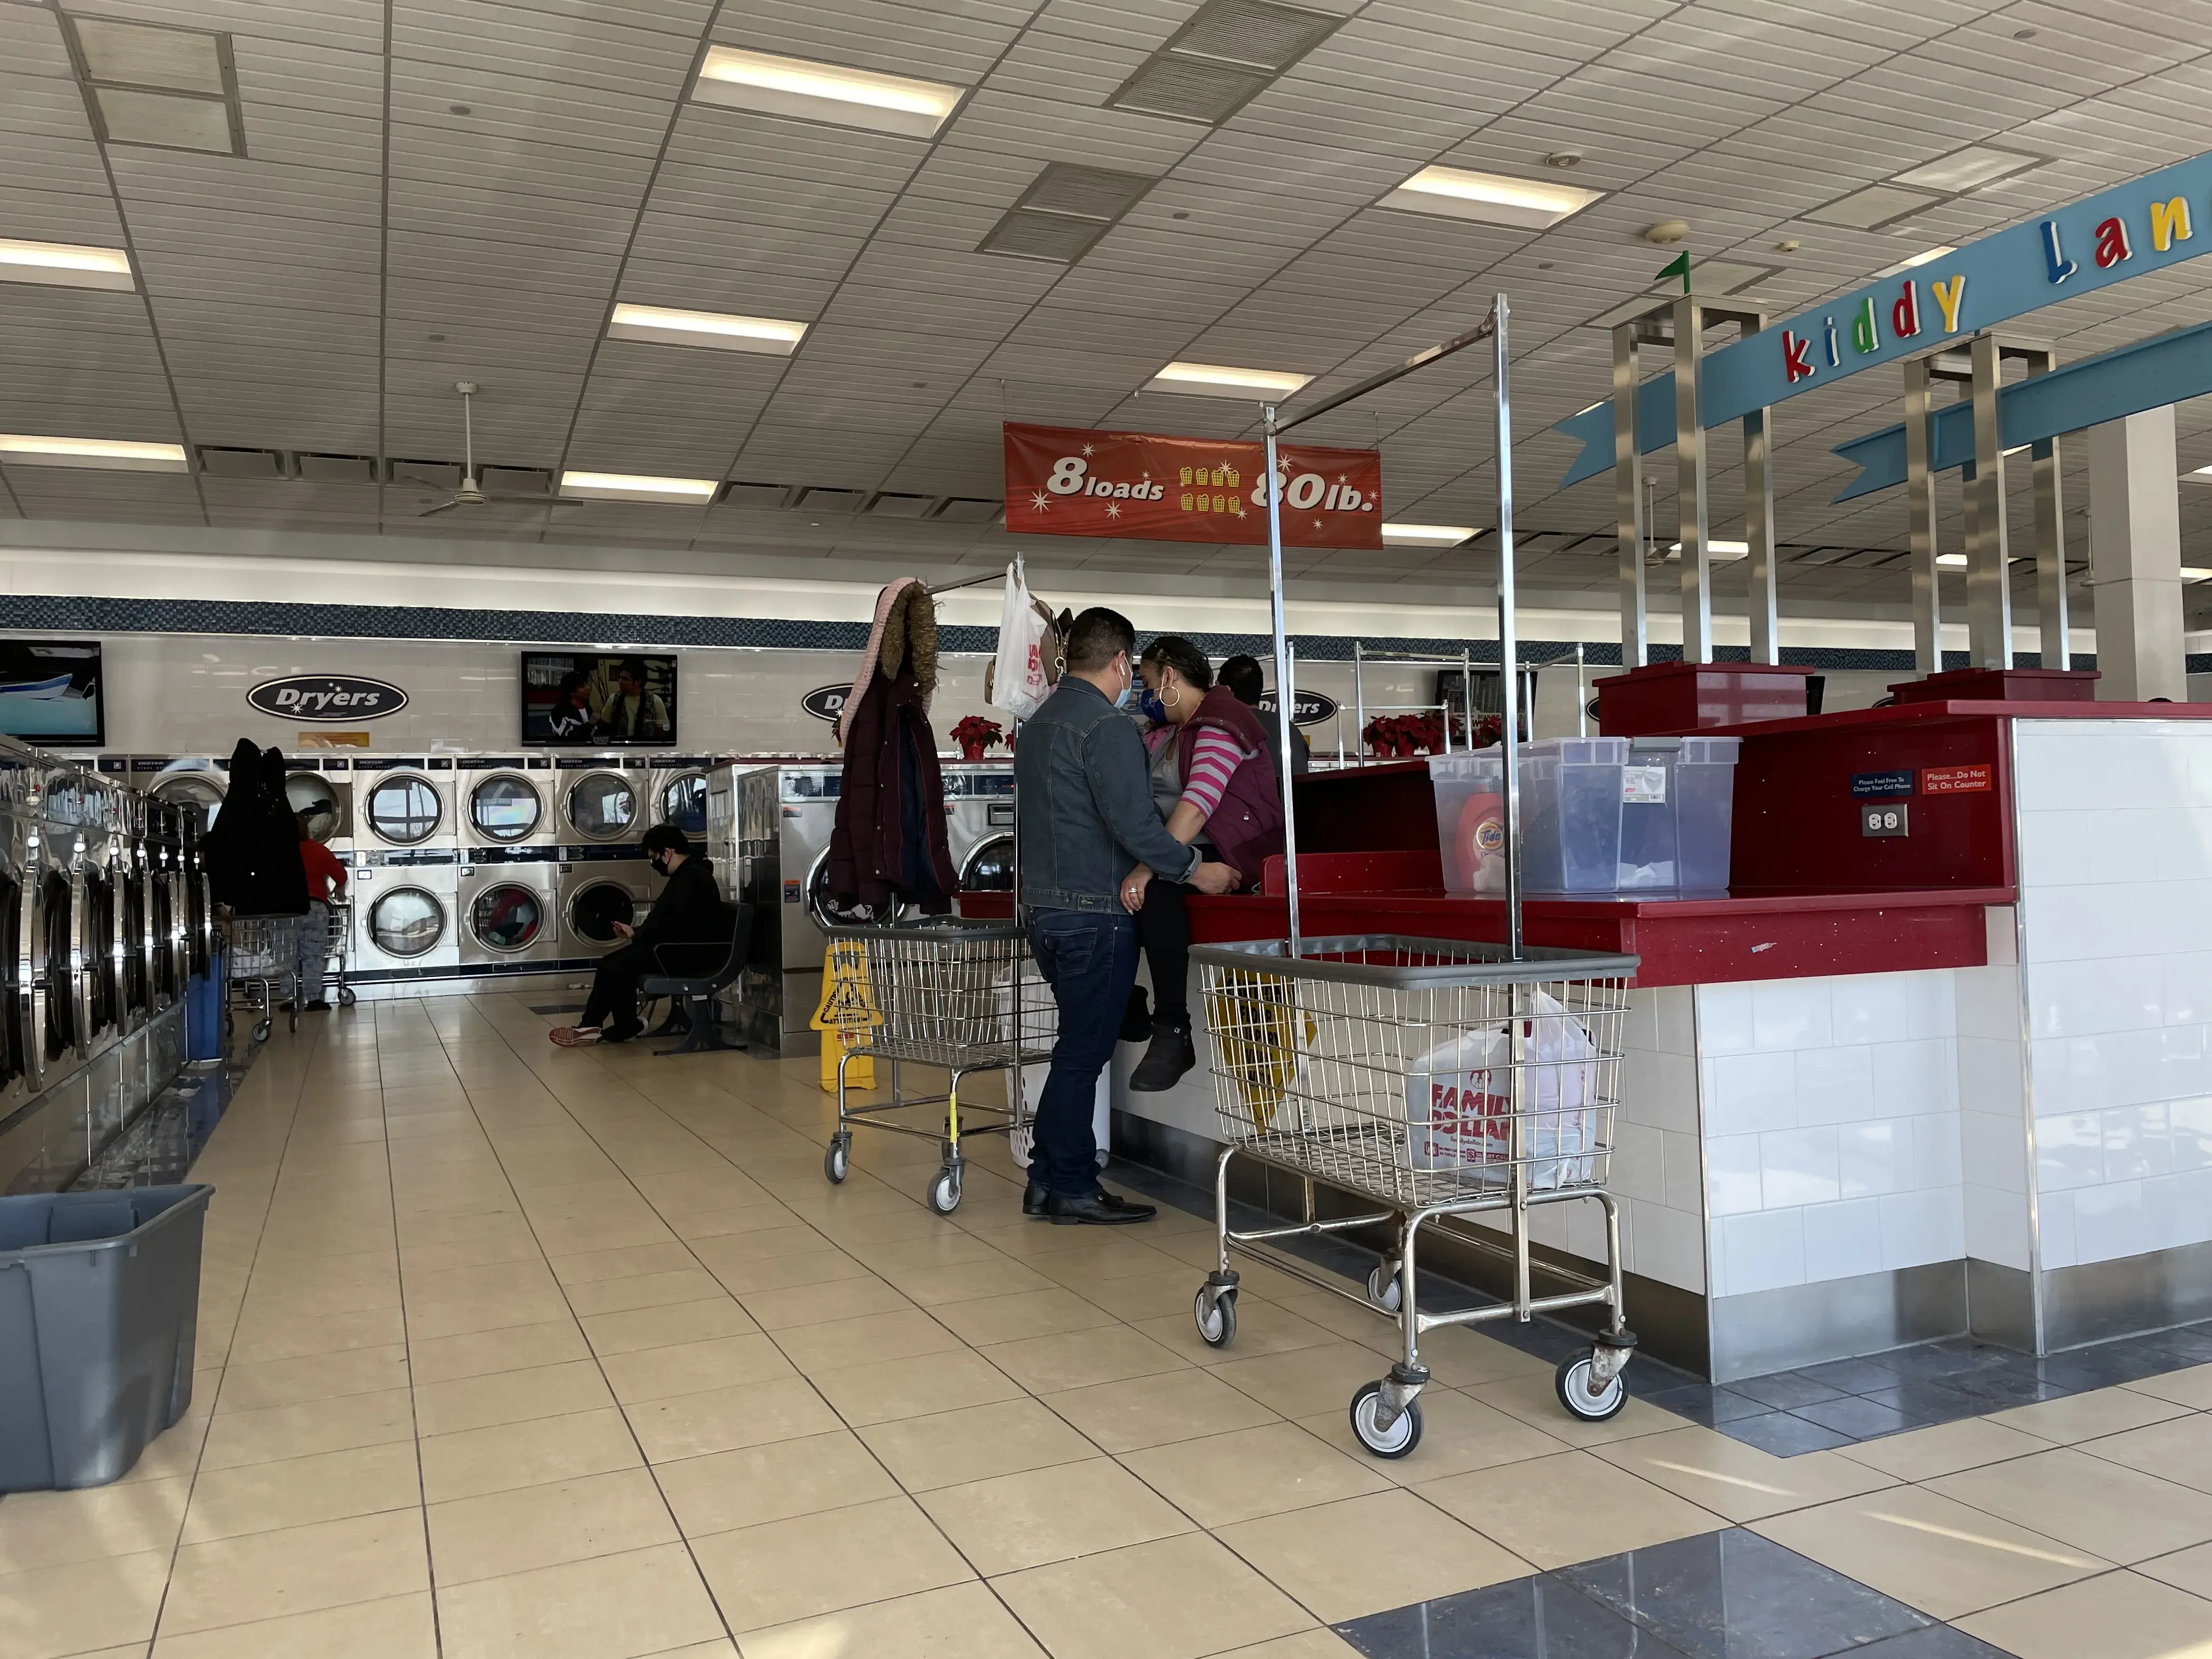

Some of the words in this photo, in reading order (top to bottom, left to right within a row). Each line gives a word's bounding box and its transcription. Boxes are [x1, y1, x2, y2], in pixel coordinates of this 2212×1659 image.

[1782, 275, 1966, 383] kiddy
[2040, 196, 2211, 284] Lan
[1047, 456, 1089, 495] 8
[1084, 478, 1165, 501] loads
[275, 688, 380, 710] Dryers
[1259, 700, 1320, 714] Drers
[1970, 770, 1986, 778] Not
[1481, 829, 1501, 845] Tide
